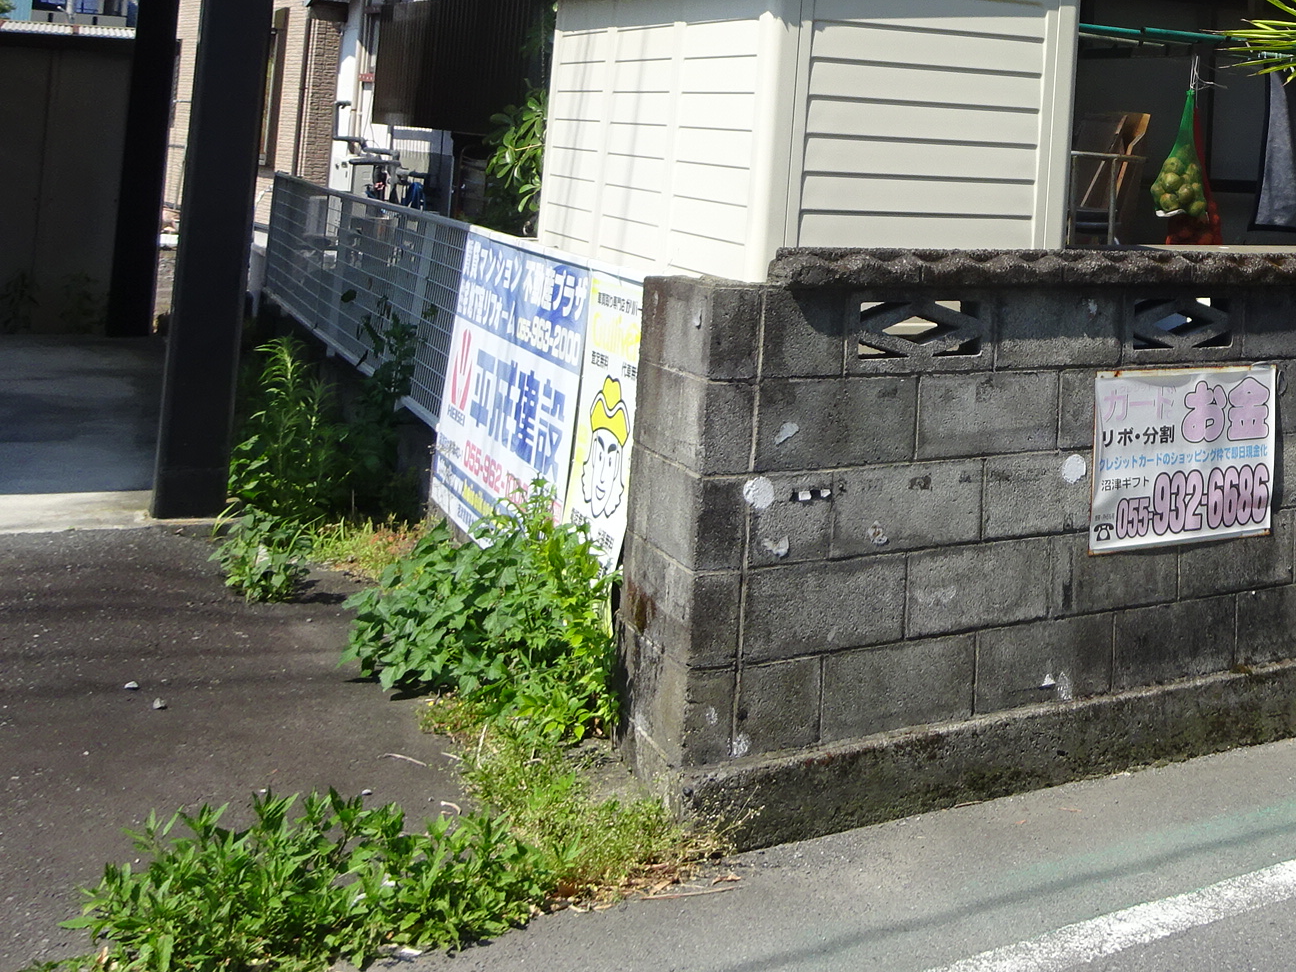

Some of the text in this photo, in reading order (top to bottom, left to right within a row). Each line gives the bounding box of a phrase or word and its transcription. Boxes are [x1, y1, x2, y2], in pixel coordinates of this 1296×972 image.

[523, 259, 589, 321] 不動産プラザ
[516, 315, 581, 366] 055-963-2000
[469, 348, 566, 483] 平成建設
[1102, 424, 1175, 448] リボ・分割
[1181, 376, 1270, 443] お金
[1099, 444, 1268, 472] クレジットカードのショッピング枠で即日現金化
[1101, 475, 1150, 492] 沼津ギフト
[1116, 462, 1270, 540] 055-932-6686
